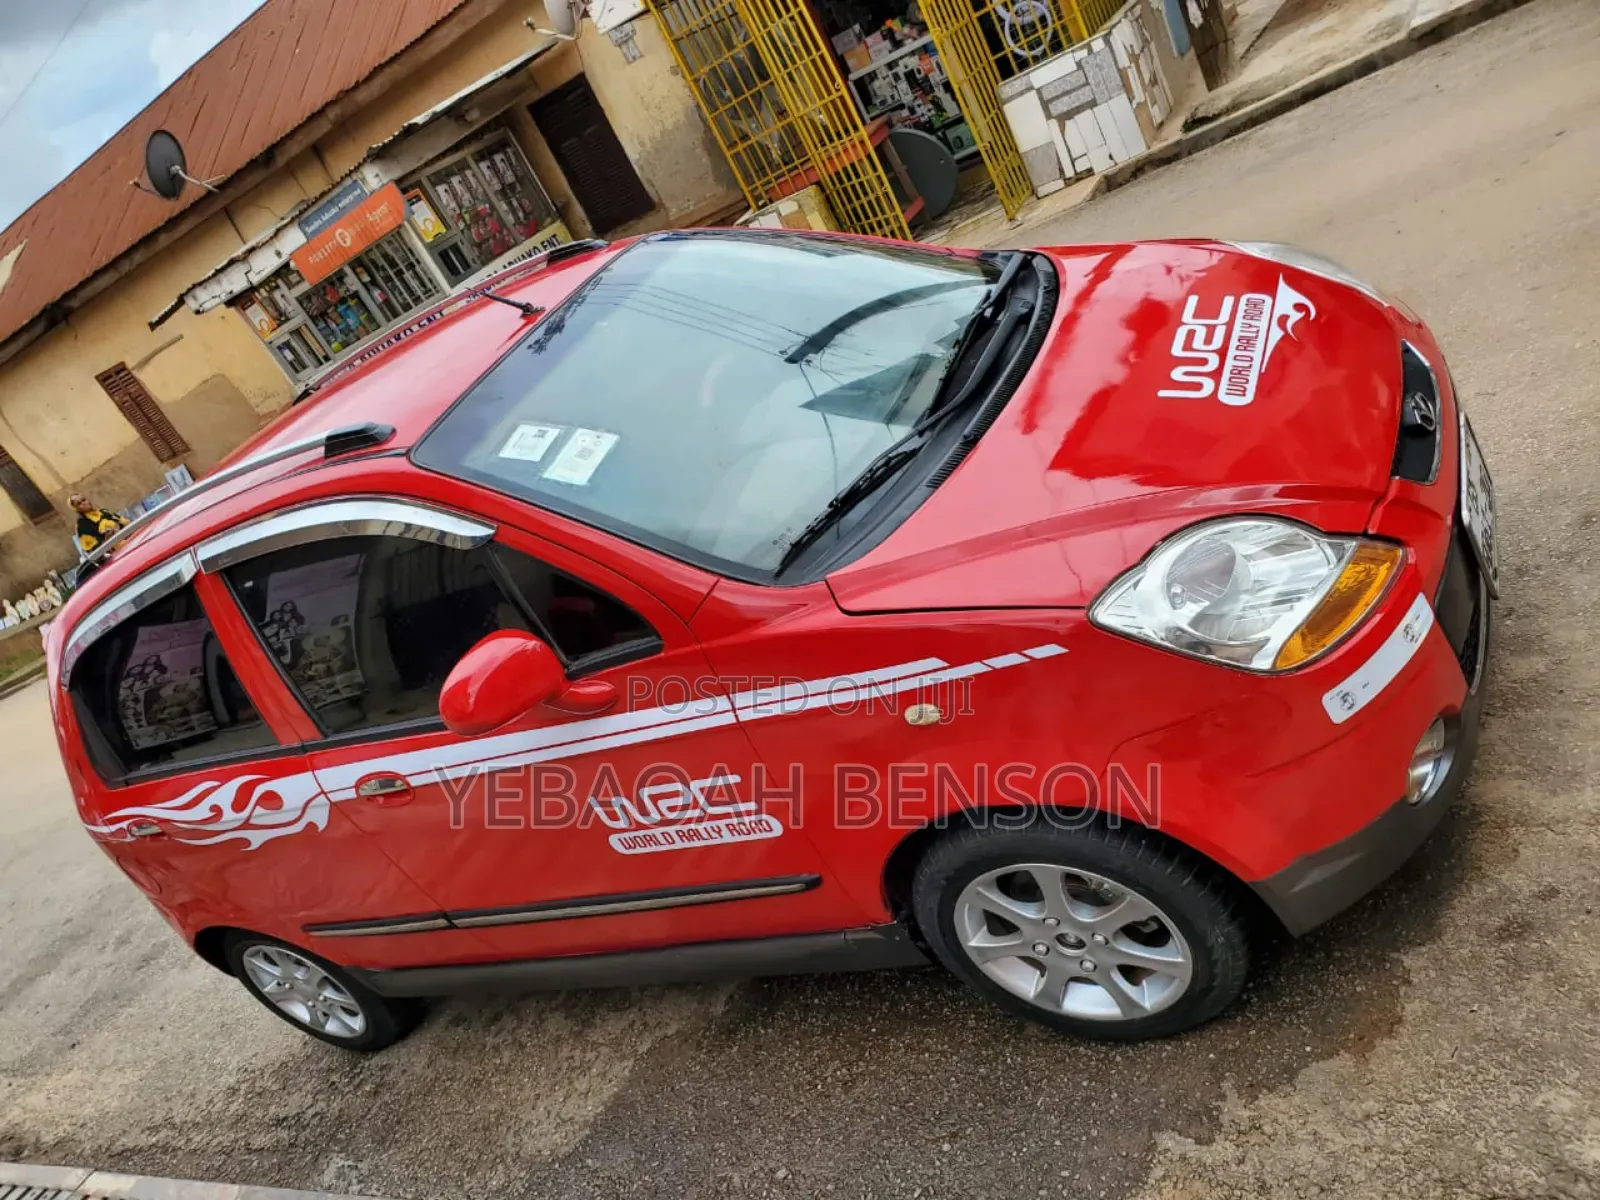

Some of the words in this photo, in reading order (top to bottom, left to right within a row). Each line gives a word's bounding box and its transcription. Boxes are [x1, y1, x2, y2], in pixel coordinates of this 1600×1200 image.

[1245, 297, 1265, 325] ROAD
[1157, 295, 1235, 398] WRC
[1237, 322, 1262, 352] RALLY
[1225, 354, 1254, 397] WORLD
[589, 774, 758, 828] WRC
[617, 831, 676, 851] WORLD
[675, 825, 722, 843] RALLY
[725, 818, 773, 838] ROAD
